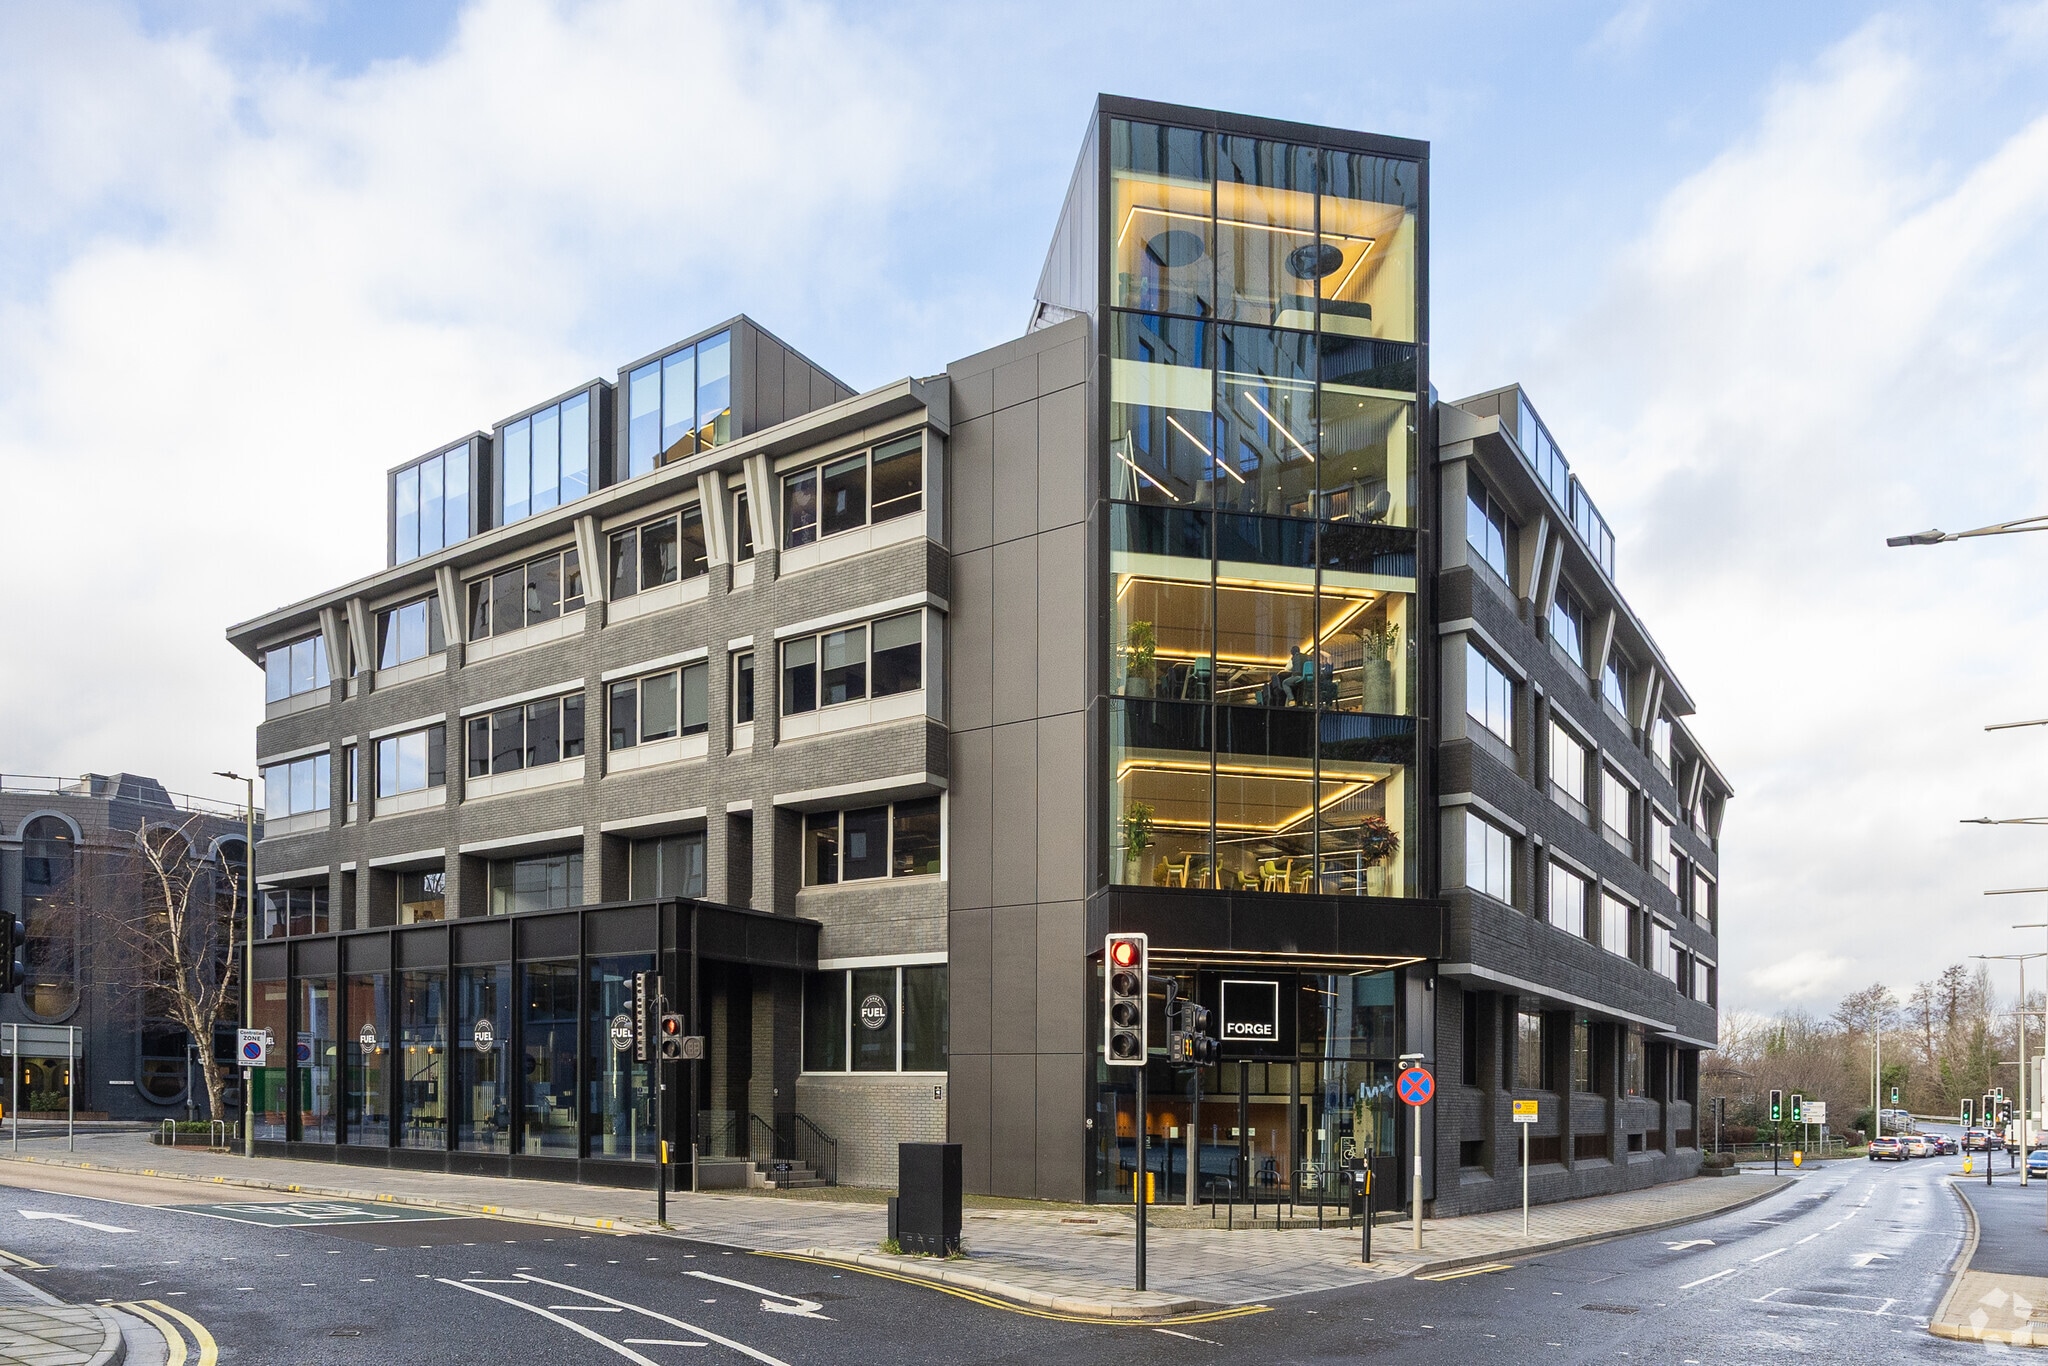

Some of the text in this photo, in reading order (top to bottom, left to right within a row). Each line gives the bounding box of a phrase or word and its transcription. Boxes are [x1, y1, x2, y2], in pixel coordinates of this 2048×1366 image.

[861, 1007, 885, 1017] FUEL
[610, 1028, 633, 1038] FUEL
[1227, 1022, 1272, 1035] FORGE
[360, 1034, 377, 1043] FUEL
[474, 1031, 493, 1041] FUEL
